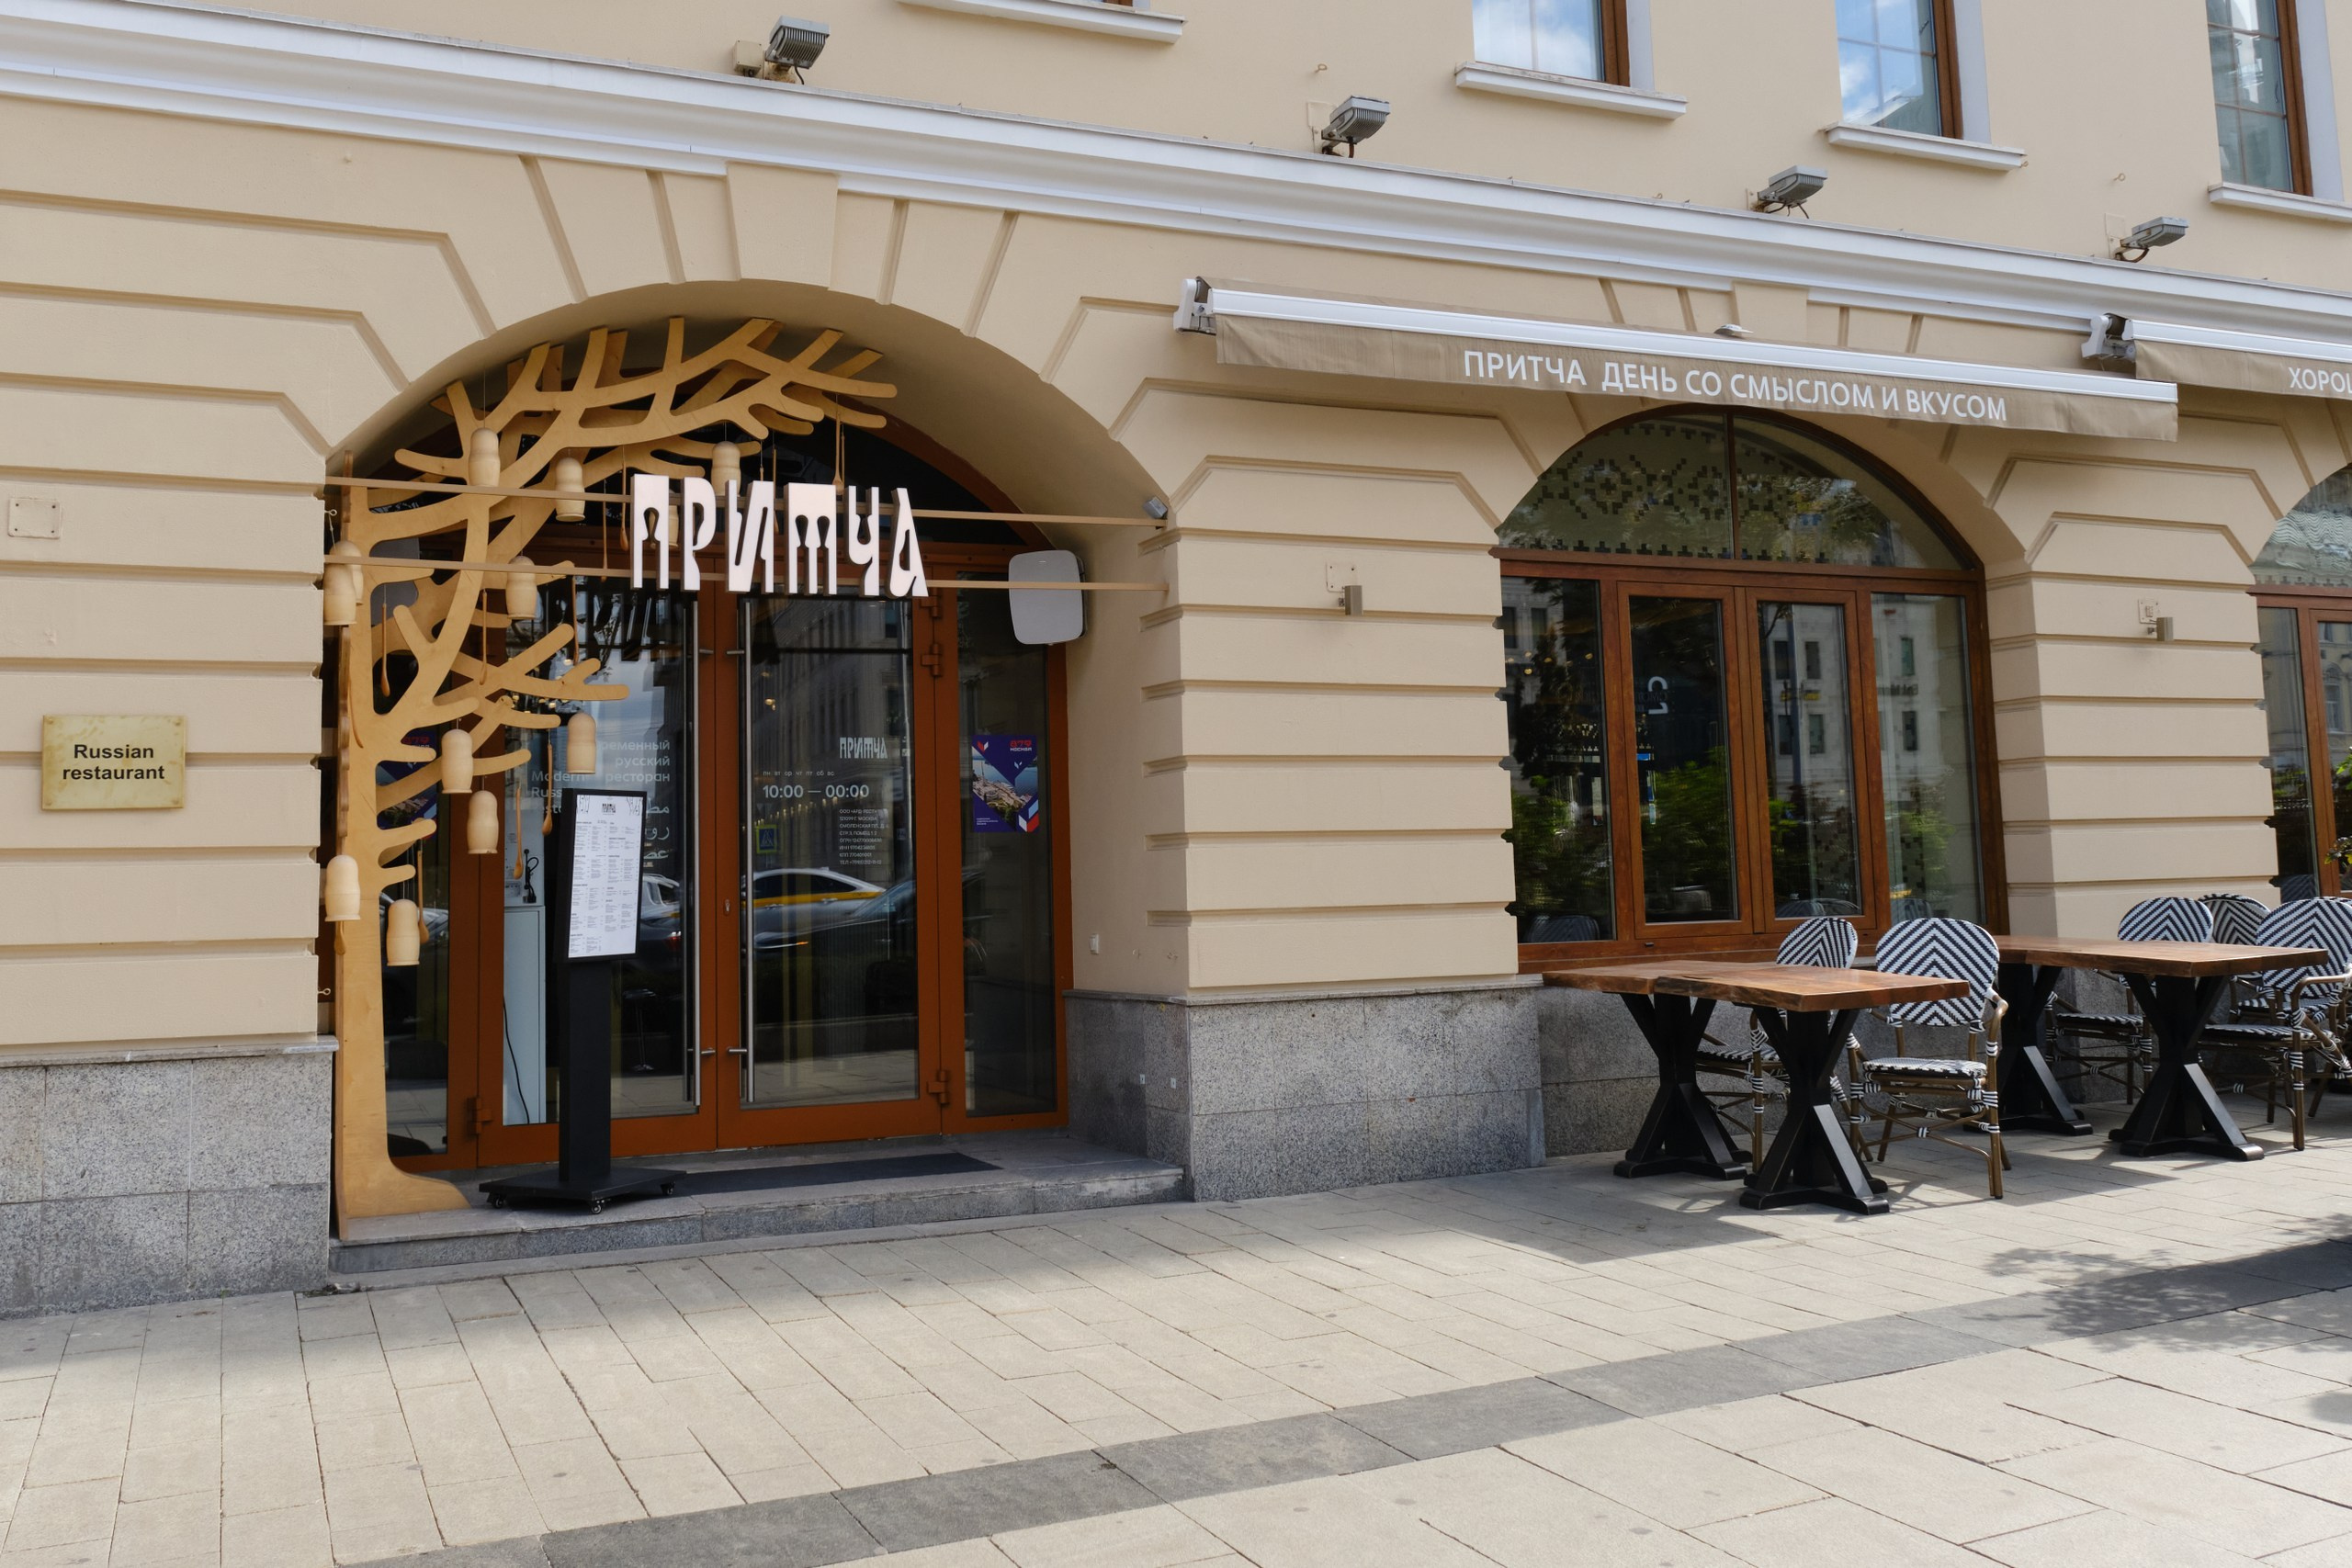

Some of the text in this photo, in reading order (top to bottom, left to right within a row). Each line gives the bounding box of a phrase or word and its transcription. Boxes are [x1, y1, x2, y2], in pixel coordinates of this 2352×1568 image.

[1464, 350, 2007, 422] ПРИТЧА ДЕНЬ СО СМЫСЛОМ И ВКУСОМ
[631, 473, 930, 598] ПРИТЧА
[74, 744, 154, 759] Russian
[839, 737, 888, 760] ПРИТЧА
[615, 756, 671, 768] русский
[62, 765, 165, 781] restaurant
[605, 773, 671, 784] ресторан
[763, 784, 804, 798] 10:00
[825, 784, 869, 798] 00:00
